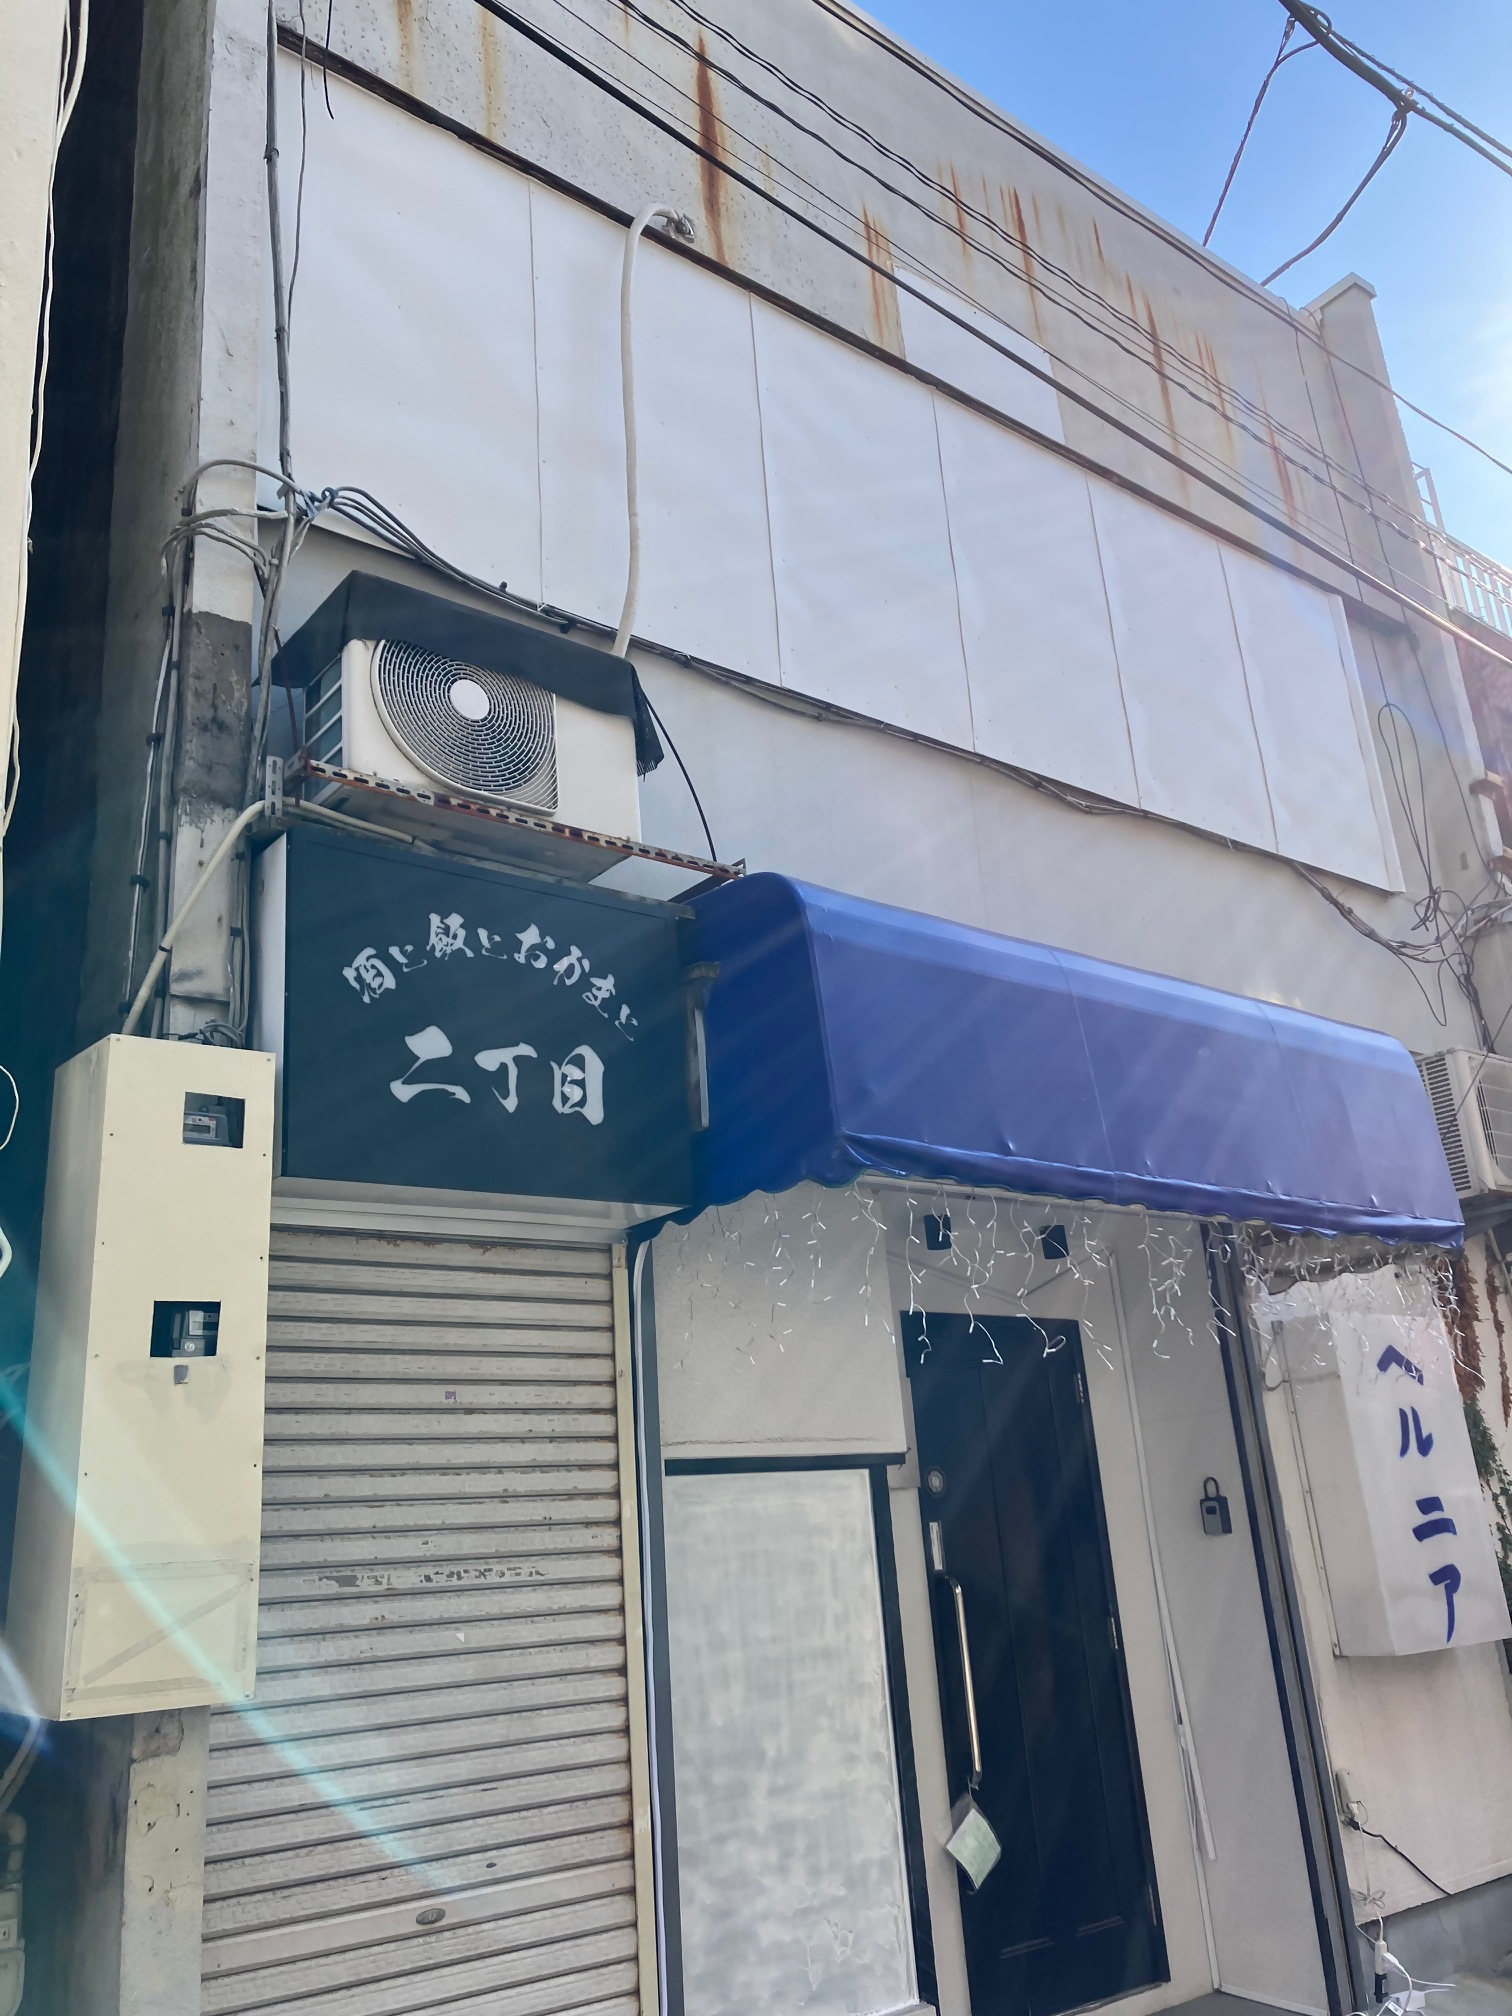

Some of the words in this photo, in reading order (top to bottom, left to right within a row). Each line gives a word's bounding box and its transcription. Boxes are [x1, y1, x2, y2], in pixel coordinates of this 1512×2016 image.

[390, 1025, 605, 1125] 二丁目
[1377, 1345, 1461, 1643] ヘルニア
